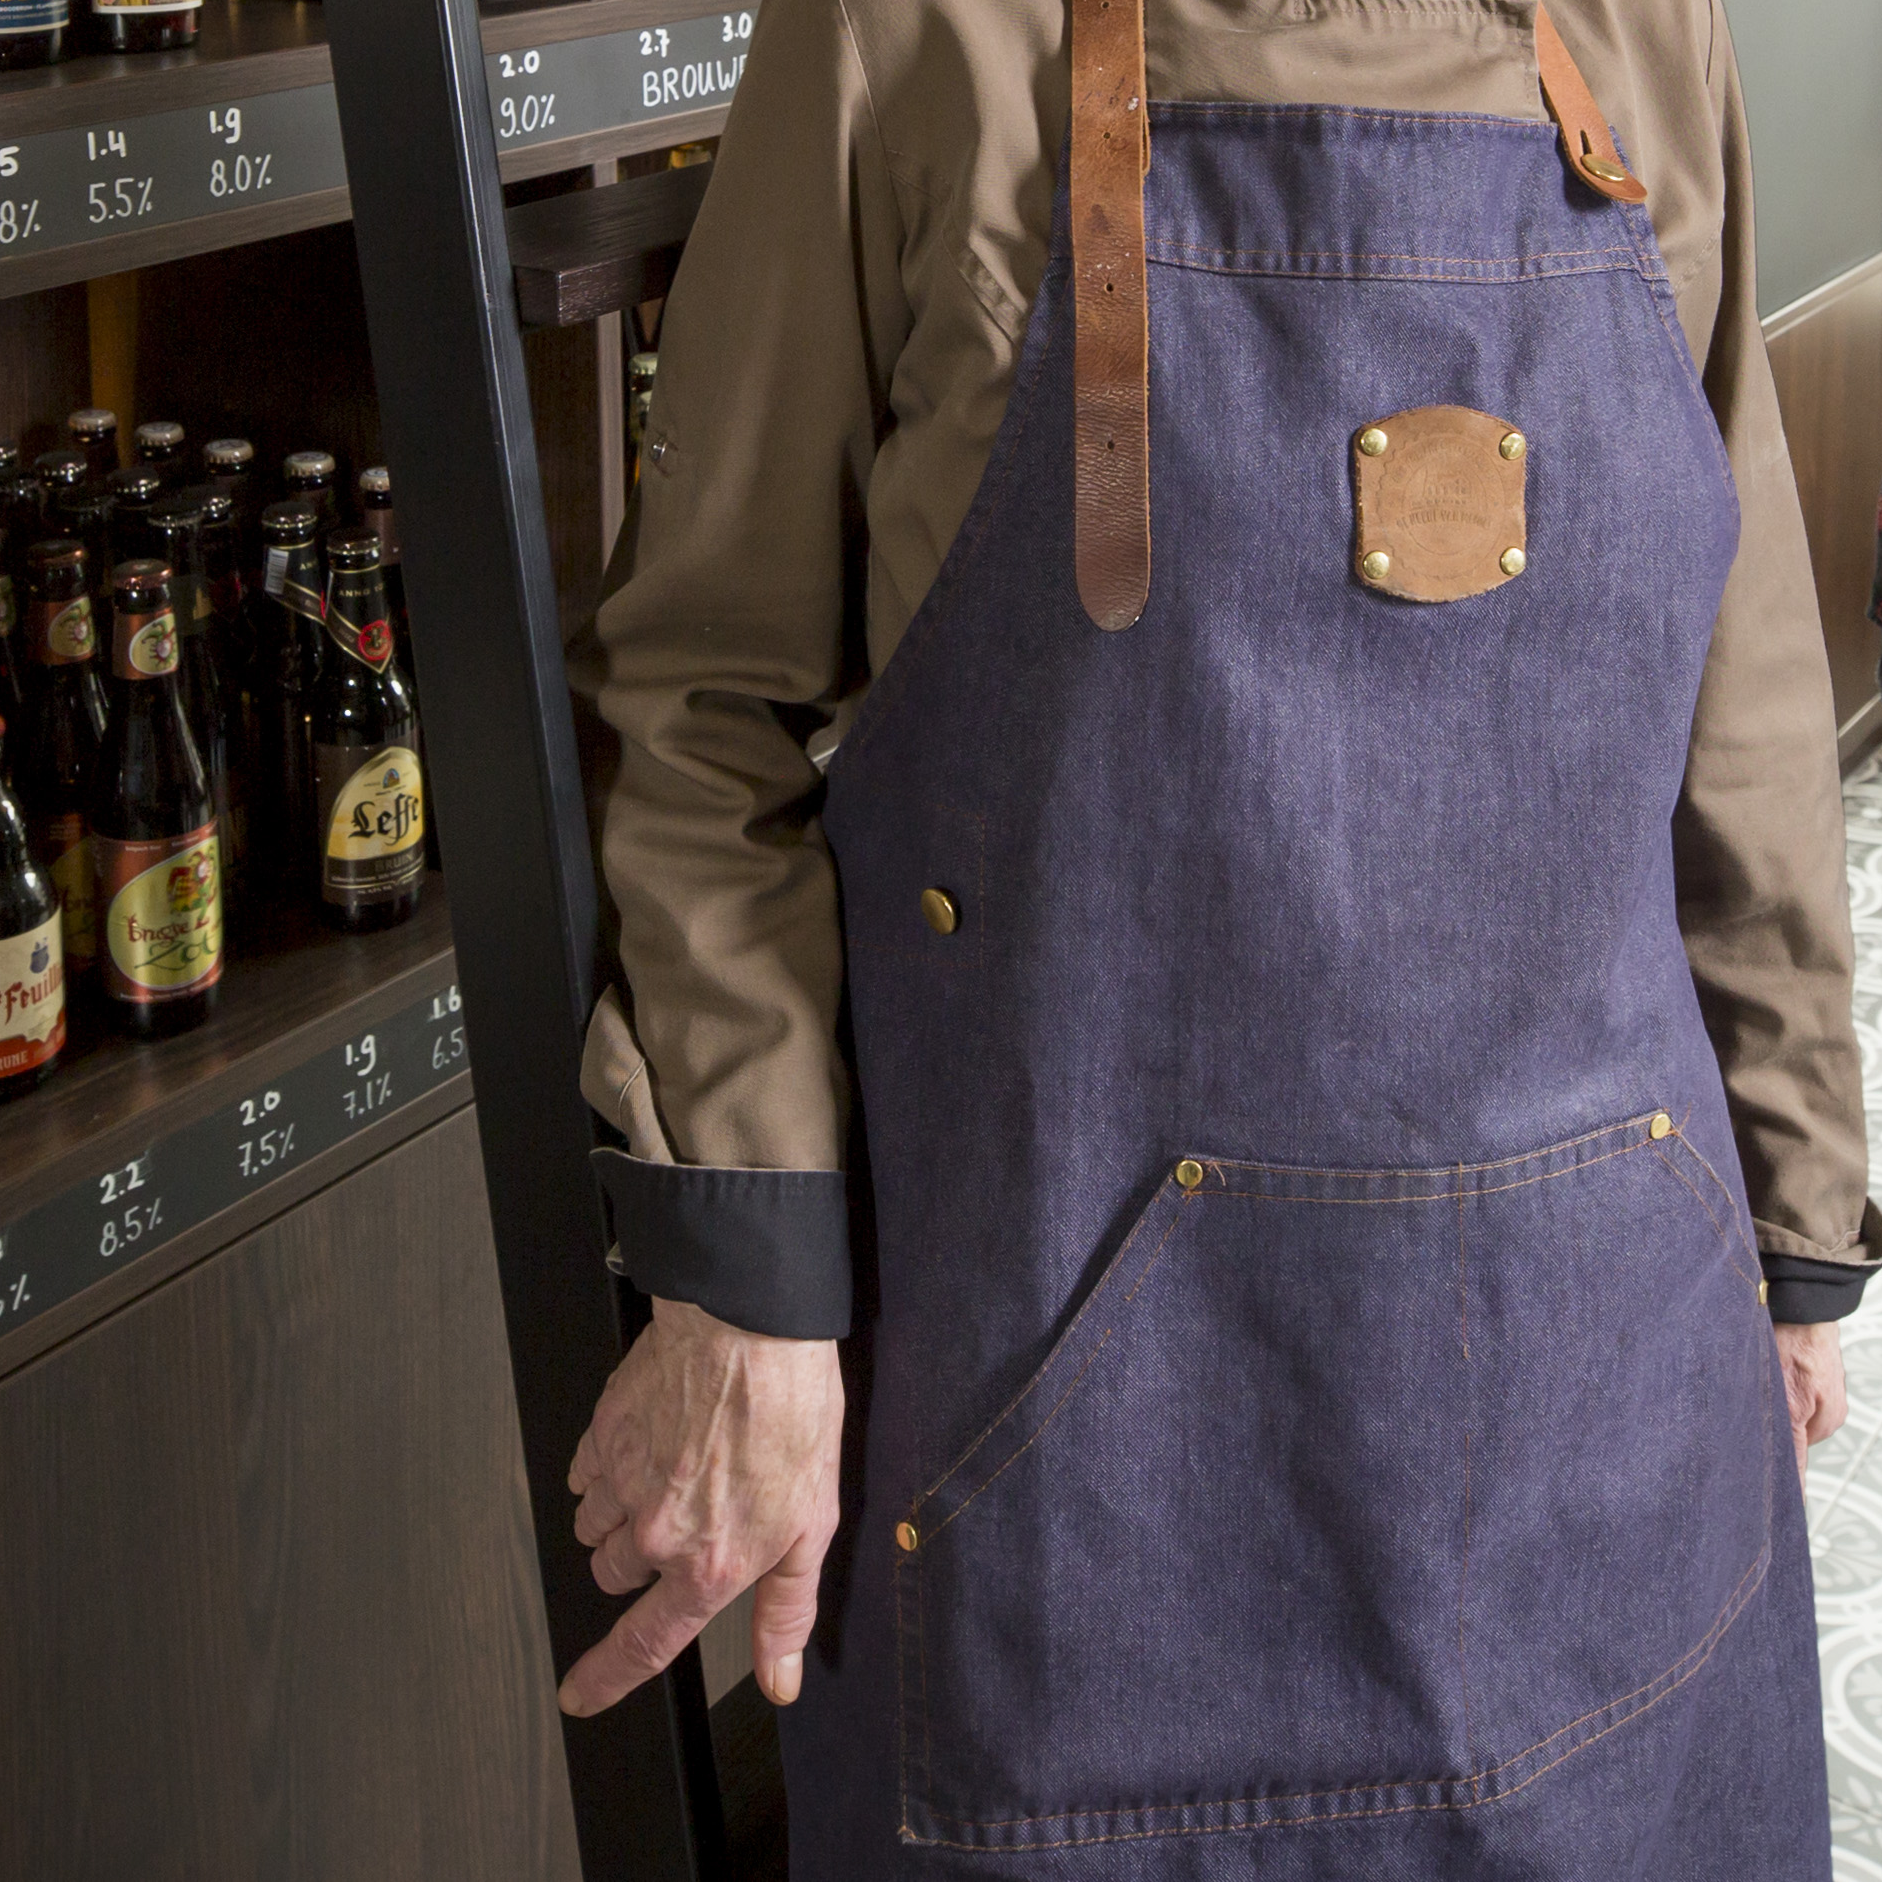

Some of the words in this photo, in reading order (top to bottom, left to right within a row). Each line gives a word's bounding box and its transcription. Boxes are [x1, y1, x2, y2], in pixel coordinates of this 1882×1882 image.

[639, 28, 671, 58] 2.7
[722, 12, 753, 43] 3.0
[499, 50, 540, 78] 2.0
[209, 107, 241, 144] 1.9
[500, 93, 556, 138] 9.0%
[87, 130, 127, 161] 1.4
[210, 153, 272, 197] 8.0%
[89, 177, 153, 224] 5.5%
[348, 792, 421, 848] Leffe
[345, 1034, 376, 1077] 1.9
[239, 1091, 281, 1126] 2.0
[342, 1072, 399, 1126] 7.1%
[238, 1123, 294, 1177] 7.5%
[99, 1160, 145, 1204] 2.2
[99, 1197, 163, 1257] 8.5%
